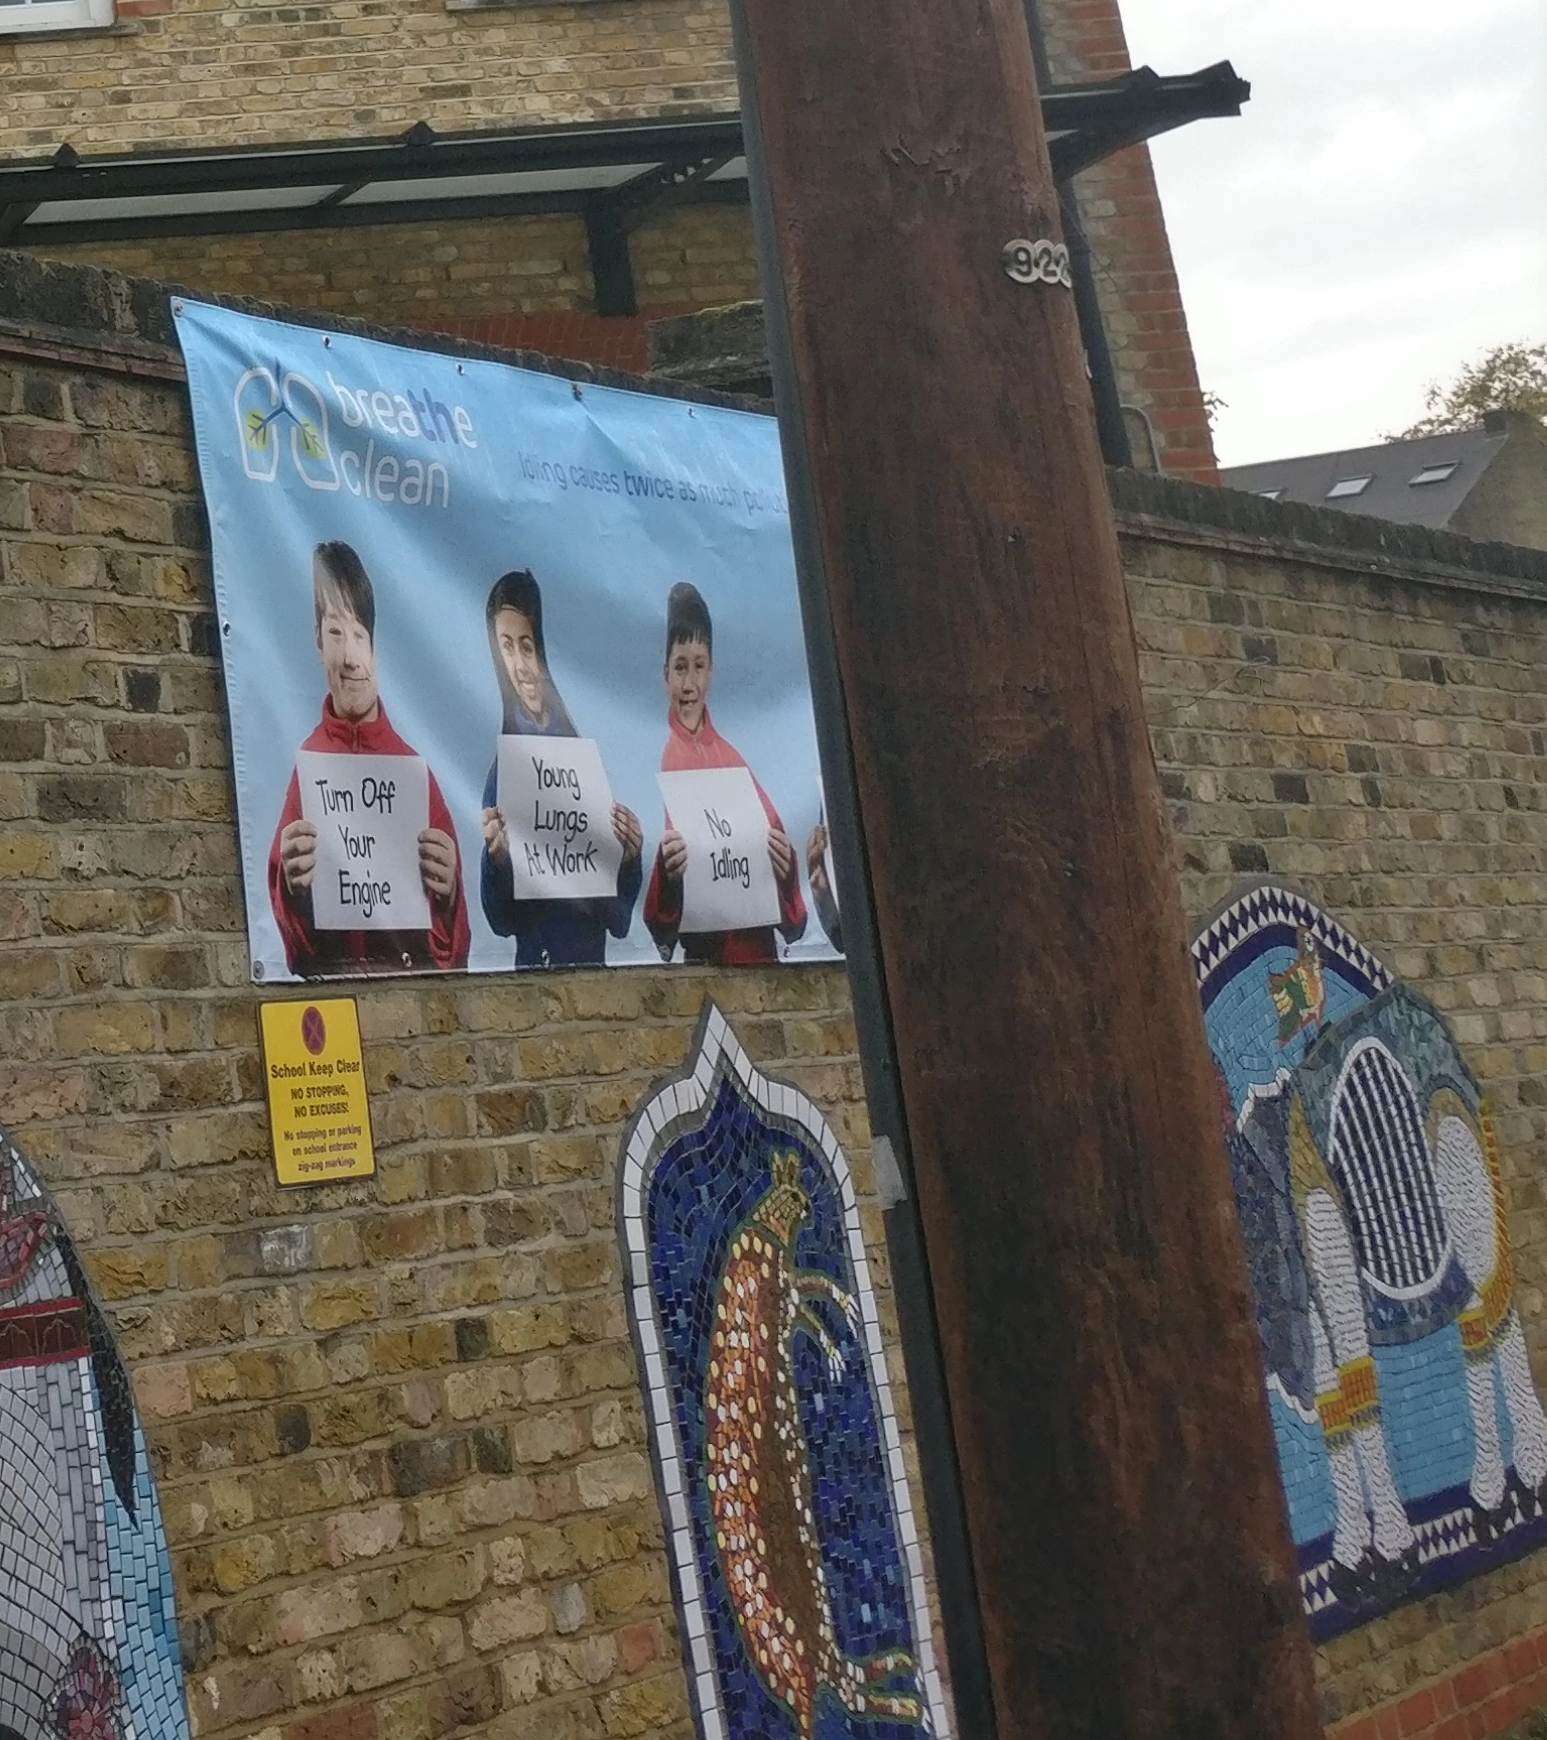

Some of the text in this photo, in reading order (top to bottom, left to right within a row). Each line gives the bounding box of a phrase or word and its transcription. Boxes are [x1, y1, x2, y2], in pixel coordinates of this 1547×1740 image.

[325, 370, 477, 448] breathe
[341, 439, 449, 508] clean
[569, 464, 619, 493] causes
[624, 470, 674, 500] twice
[679, 480, 697, 502] as
[315, 777, 396, 815] Turn Off
[532, 756, 581, 800] Young
[534, 800, 588, 843] Lungs
[703, 808, 732, 839] No
[338, 824, 375, 860] Your
[524, 838, 598, 876] At Work
[709, 848, 749, 889] Idling
[338, 869, 391, 918] Engine
[271, 1059, 360, 1078] School Keep Clear
[291, 1084, 349, 1100] NO STOPPING,
[294, 1102, 349, 1118] NO EXCUSES!
